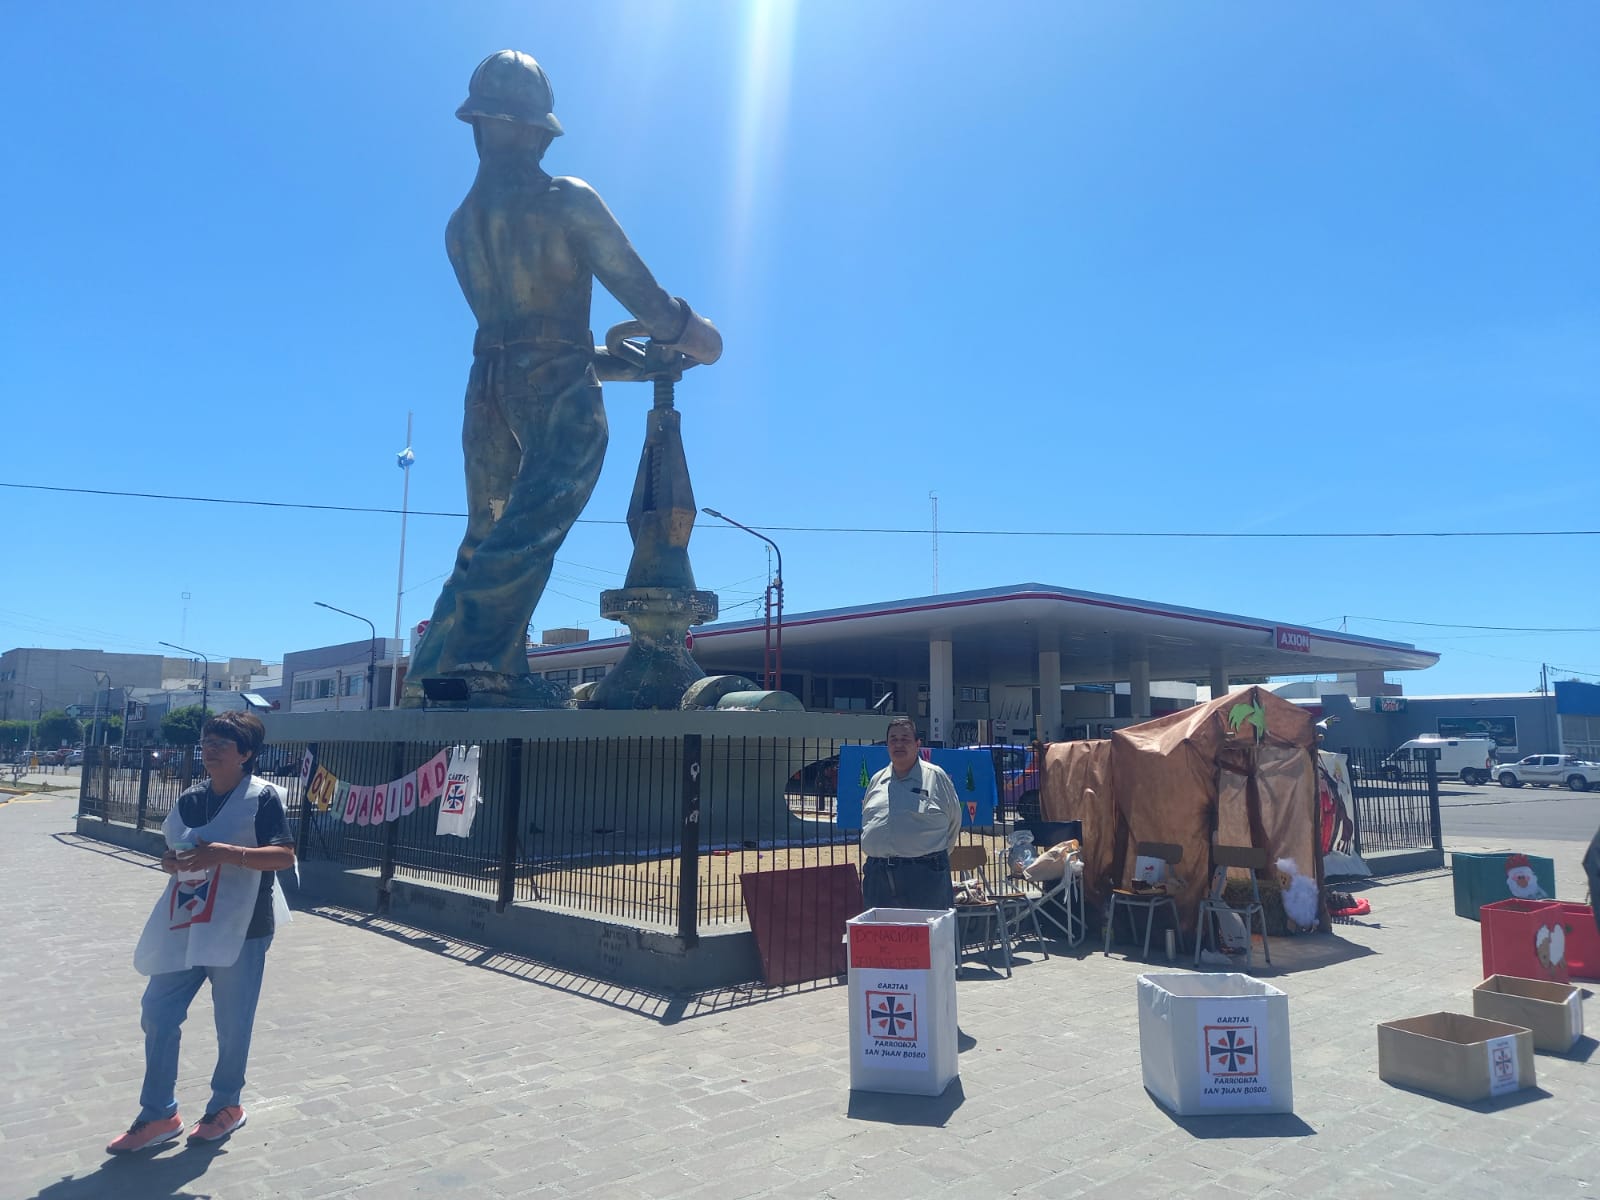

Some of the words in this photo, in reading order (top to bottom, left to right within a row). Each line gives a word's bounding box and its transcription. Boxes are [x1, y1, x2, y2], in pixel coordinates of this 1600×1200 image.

[1281, 631, 1309, 648] AXION
[302, 757, 446, 817] SOLIDARIDAD
[877, 982, 909, 991] CARITAS
[1217, 1015, 1250, 1024] CARITAS
[864, 1048, 880, 1056] SAN
[881, 1049, 902, 1057] JUAN
[902, 1051, 926, 1059] BOSCO
[1203, 1087, 1219, 1095] SAN
[1220, 1087, 1243, 1095] JUAN
[1244, 1086, 1267, 1094] BOSCO
